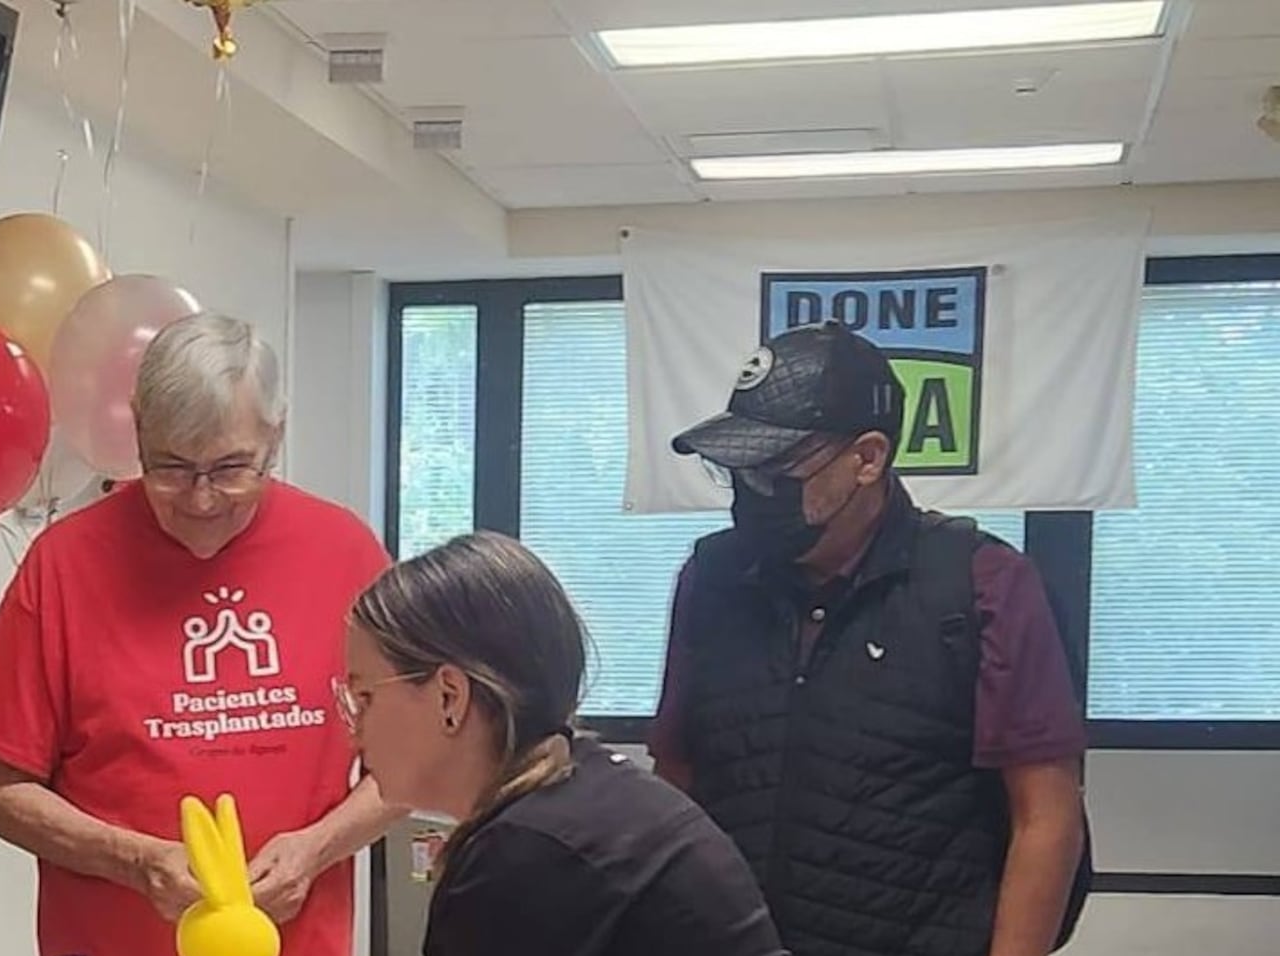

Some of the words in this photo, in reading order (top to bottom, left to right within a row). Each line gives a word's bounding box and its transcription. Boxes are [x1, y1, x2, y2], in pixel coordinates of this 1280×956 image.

[787, 287, 958, 331] DONE
[172, 686, 297, 714] Pacientes
[143, 705, 326, 741] Trasplantados
